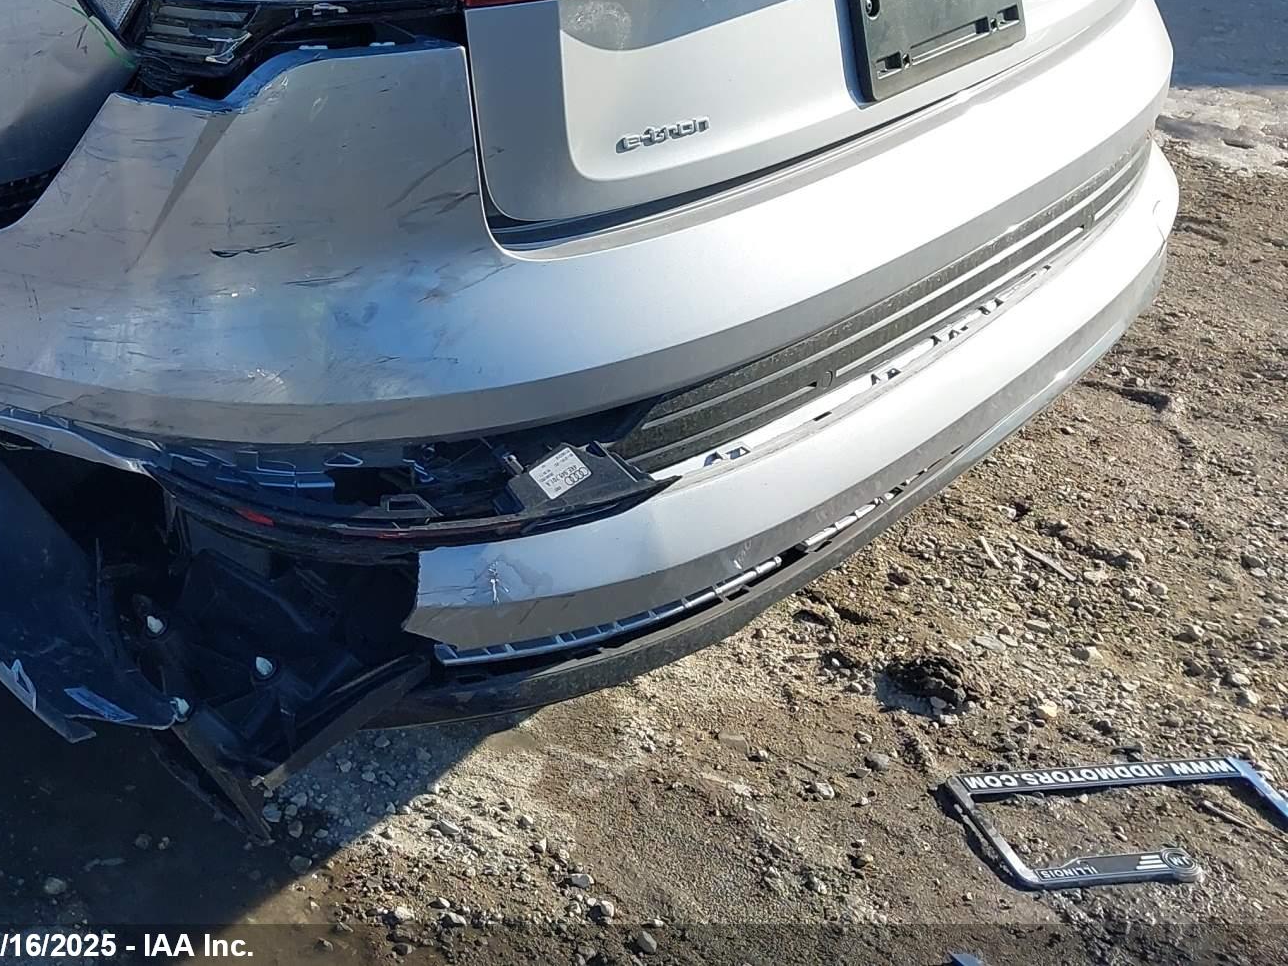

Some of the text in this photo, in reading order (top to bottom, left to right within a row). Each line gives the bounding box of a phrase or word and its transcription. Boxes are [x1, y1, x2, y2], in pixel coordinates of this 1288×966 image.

[615, 117, 710, 154] e-tron
[963, 760, 1235, 789] WWW.JIDDMOTORS.COM
[1040, 866, 1099, 879] ILLINOIS
